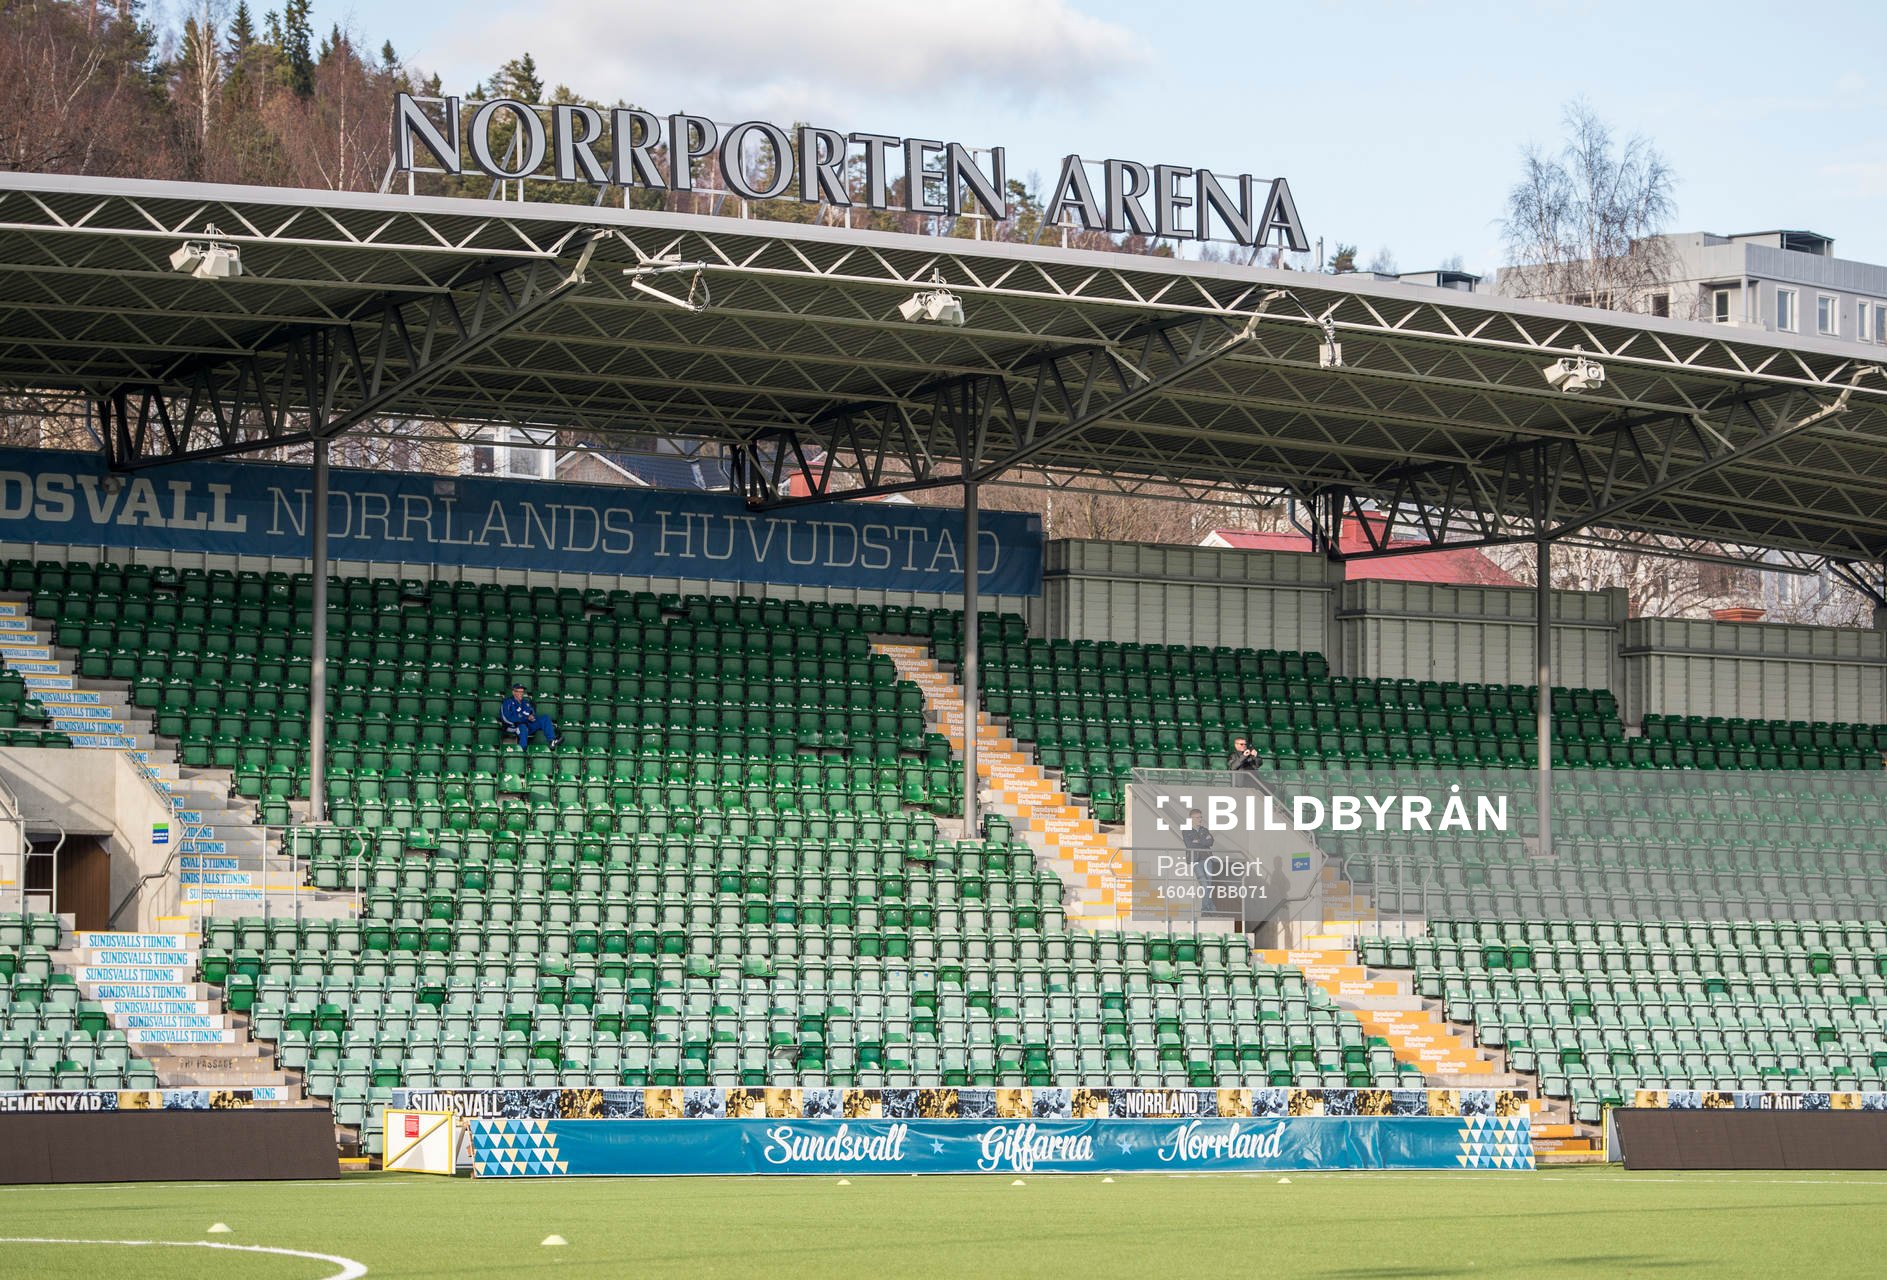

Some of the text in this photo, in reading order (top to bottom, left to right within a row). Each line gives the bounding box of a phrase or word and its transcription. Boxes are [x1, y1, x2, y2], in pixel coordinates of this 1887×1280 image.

[395, 92, 1310, 252] NORRPORTEN ARENA
[32, 692, 99, 703] SUNDSVALLS TIDNING
[85, 708, 111, 718] TIDNING
[97, 721, 123, 733] TIDNING
[209, 858, 236, 869] TIDNING
[180, 872, 250, 884] UNDSALLS TIDNING
[89, 935, 176, 948] SUNDSVALLS TIDNING
[101, 952, 187, 965] SUNDSVALLS TIDNING
[86, 968, 173, 981] SUNDSVALLS TIDNING
[98, 986, 186, 999] SUNDSVALLS TIDNING
[114, 1002, 196, 1014] SUNDSVALLS TIDNING
[128, 1015, 210, 1028] SUNDSVALLS TIDNING
[140, 1030, 222, 1042] SUNDSVALLS TIDNING
[411, 1094, 502, 1116] SUNDSVALL
[1126, 1092, 1198, 1113] NORRLAND
[764, 1121, 1285, 1171] Sundsvall Giffarna Norrland
